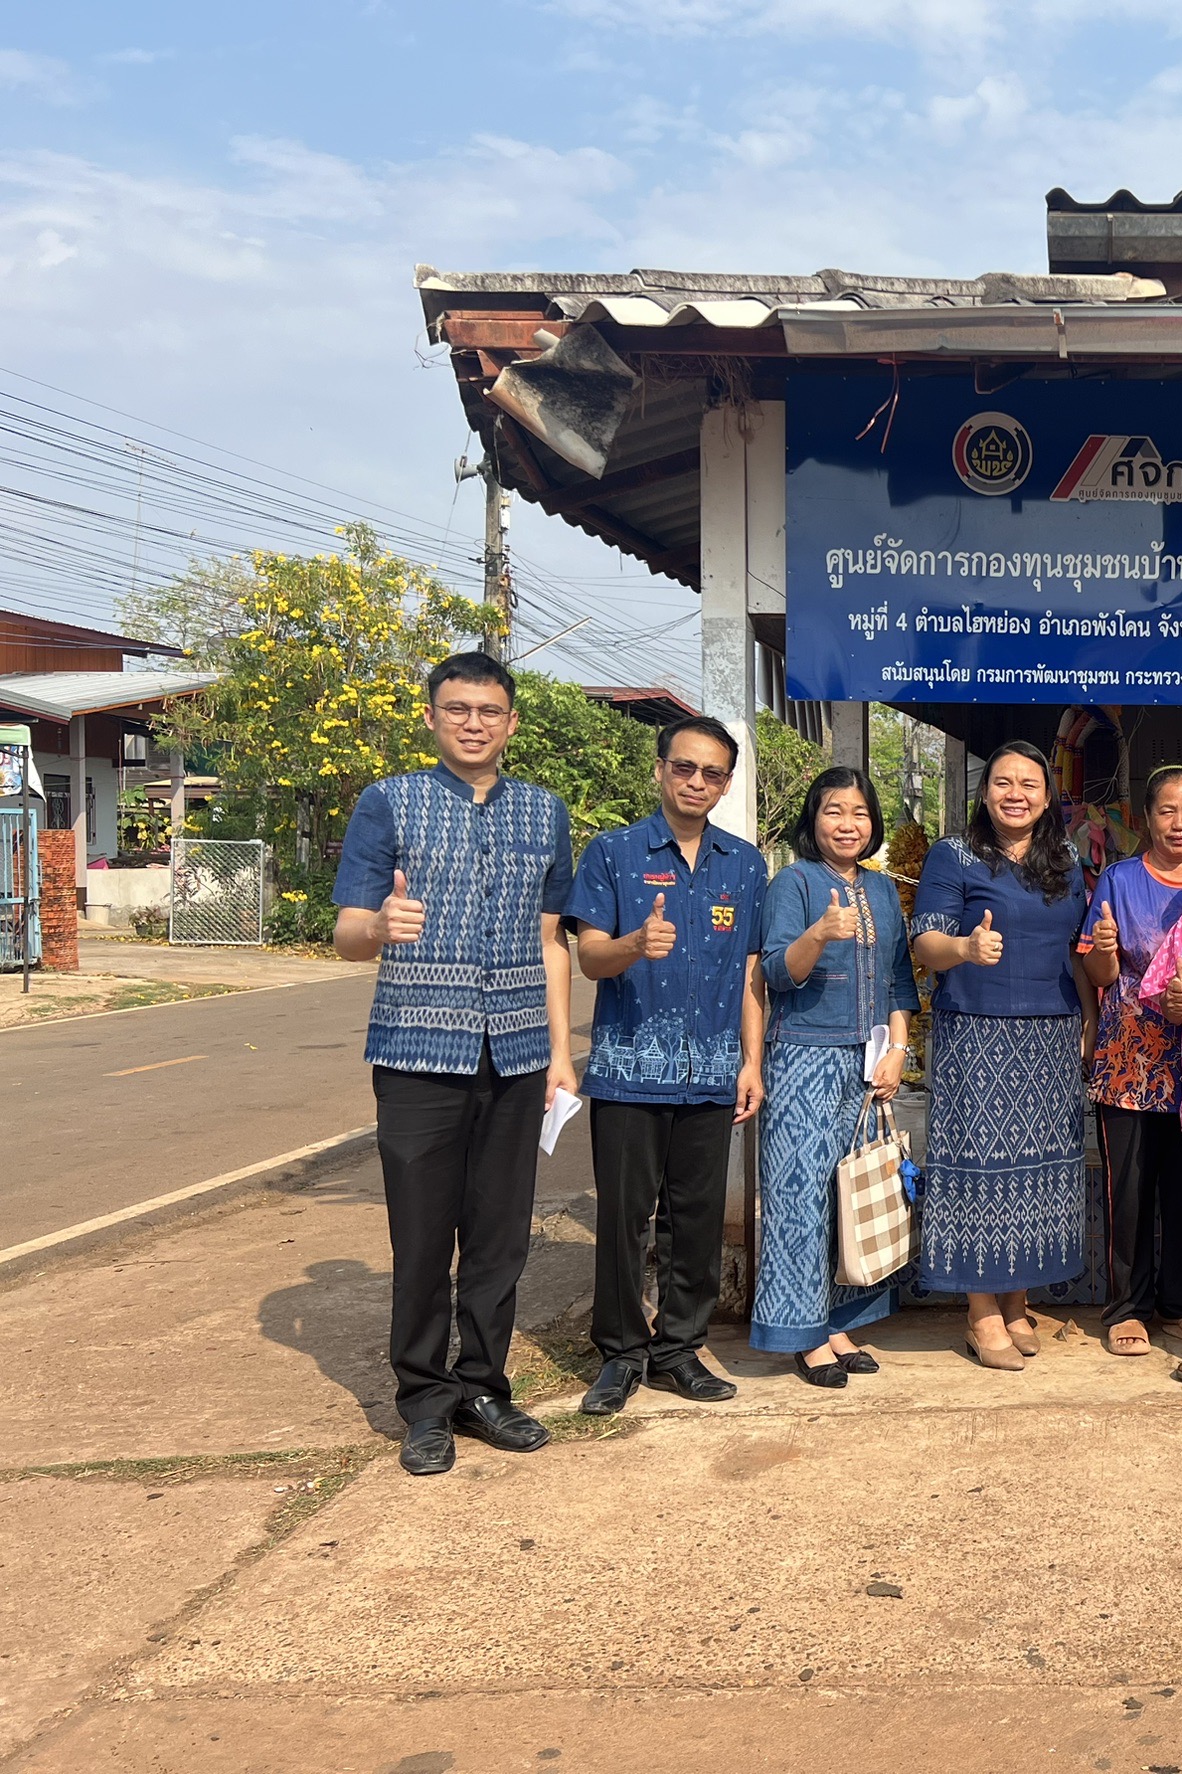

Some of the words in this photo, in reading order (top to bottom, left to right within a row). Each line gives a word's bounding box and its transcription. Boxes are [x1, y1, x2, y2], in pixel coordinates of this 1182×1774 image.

[848, 601, 888, 640] หมู่ที่
[895, 611, 908, 632] 4
[915, 605, 1032, 638] ตำบลไฮหย่อง
[1039, 609, 1151, 639] อำเภอพังโคน
[881, 659, 970, 689] สนับสนุนโดย
[976, 663, 1120, 692] กรมการพัฒนาชุมชน
[711, 905, 735, 926] 55
